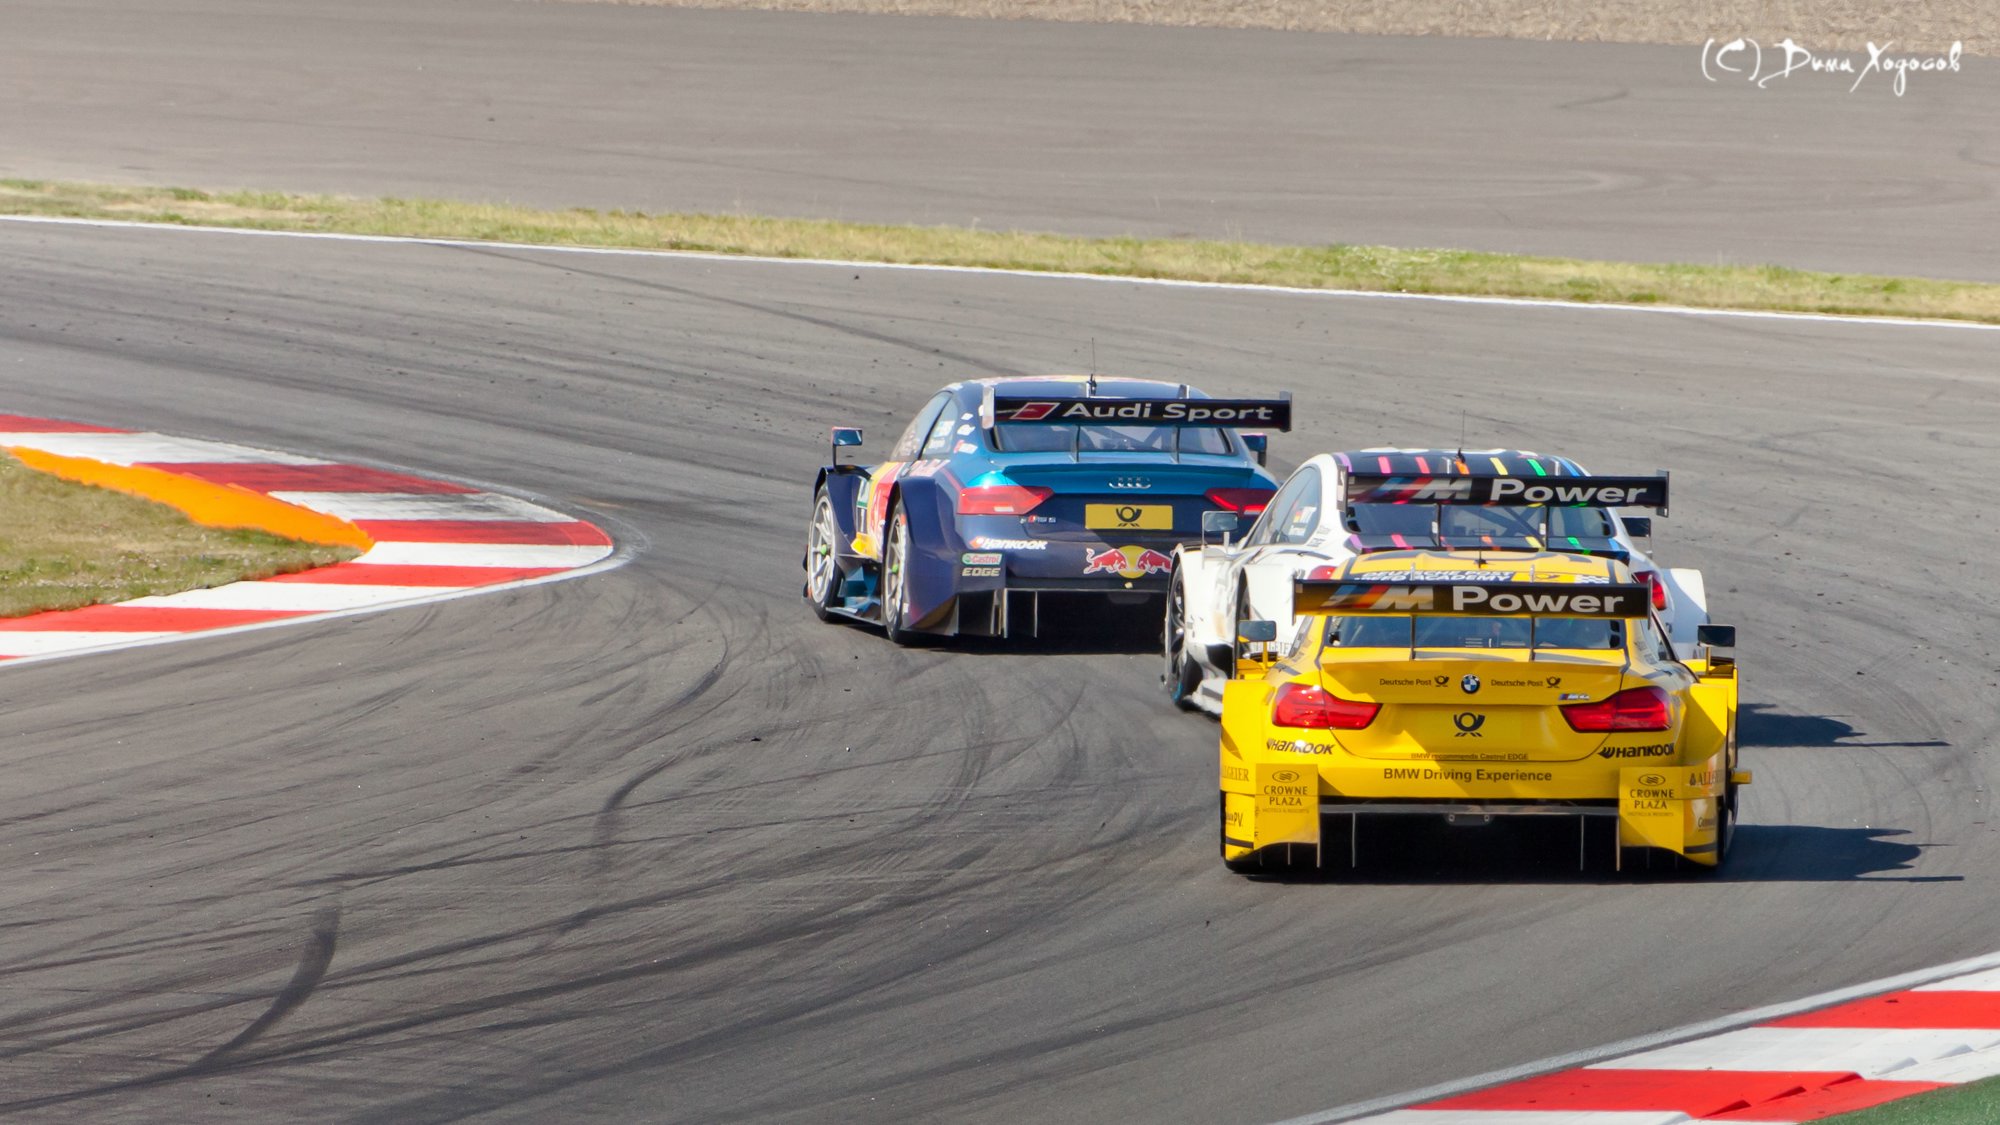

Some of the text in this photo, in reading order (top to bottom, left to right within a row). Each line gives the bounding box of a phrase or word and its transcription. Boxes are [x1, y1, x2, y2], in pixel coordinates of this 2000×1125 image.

[1062, 402, 1272, 421] Audi Sport
[1489, 478, 1648, 503] Power
[962, 567, 1001, 576] EDGE
[1452, 585, 1625, 613] Power
[1379, 678, 1432, 686] Deutsche Post
[1490, 679, 1526, 687] Deutsche
[1383, 768, 1552, 782] BMW Driving Experience
[1263, 785, 1308, 796] CROWNE
[1630, 789, 1674, 799] CROWNE
[1269, 796, 1302, 806] PLAZA
[1634, 800, 1667, 809] PLAZA
